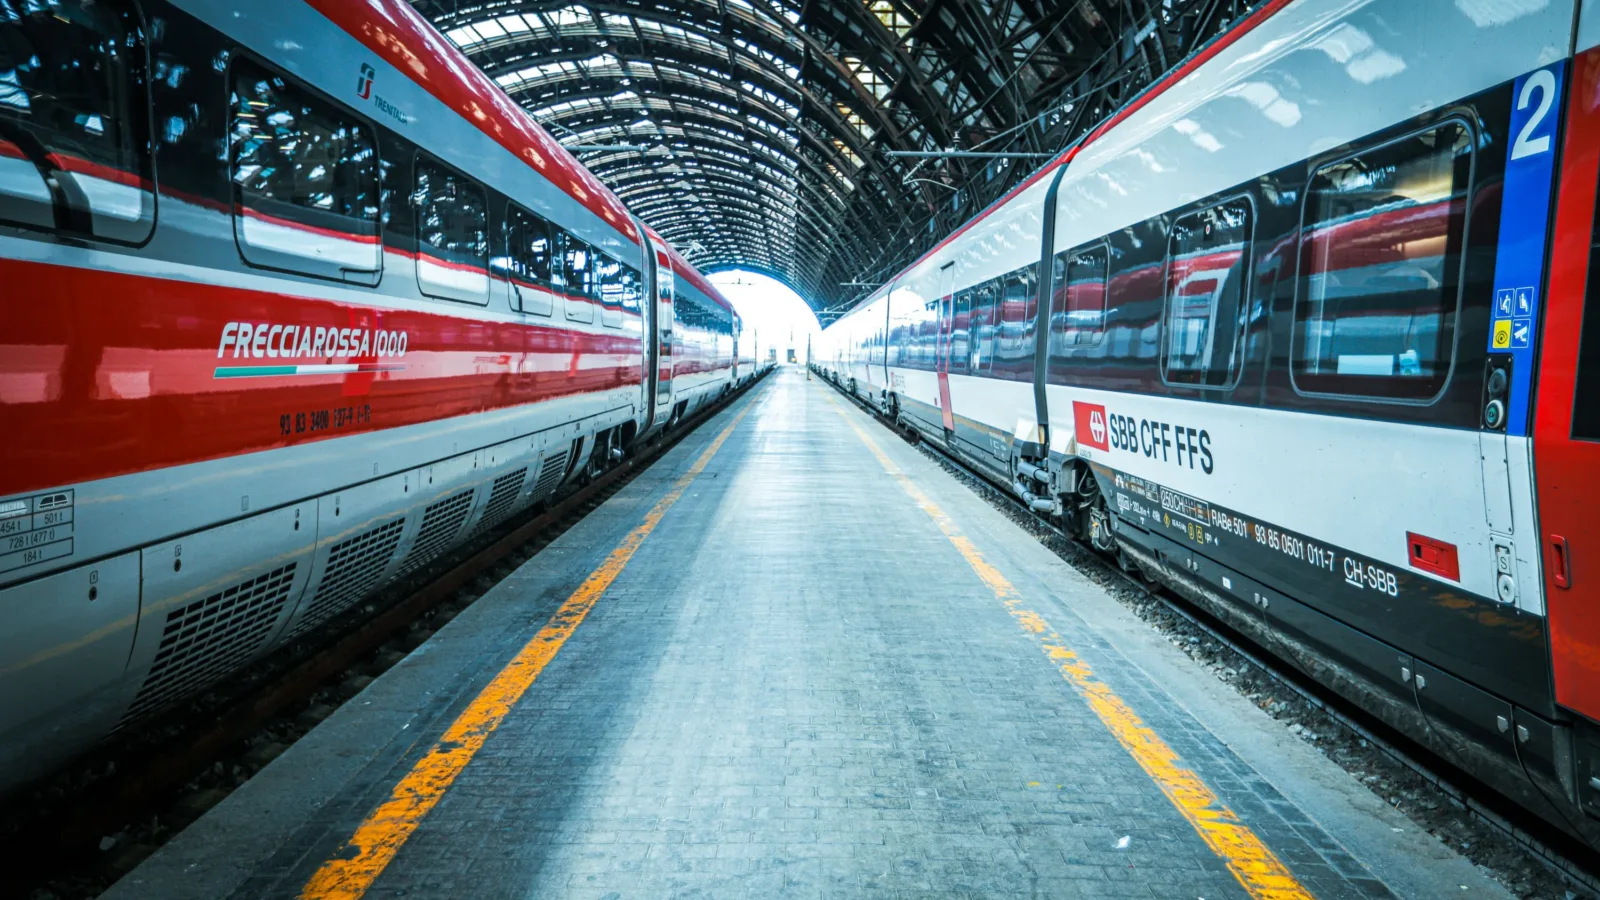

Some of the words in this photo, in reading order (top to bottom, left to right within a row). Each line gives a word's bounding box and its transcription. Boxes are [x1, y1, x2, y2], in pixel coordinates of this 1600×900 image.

[1510, 69, 1556, 161] 2
[217, 321, 370, 359] FRECCIAROSSA
[371, 330, 408, 358] 1000
[280, 413, 291, 435] 93
[295, 412, 306, 433] 83
[310, 409, 329, 431] 3400
[1109, 413, 1139, 453] SBB
[1140, 418, 1171, 462] CFF
[1174, 425, 1214, 475] FFS
[0, 521, 16, 533] 454
[44, 513, 58, 524] 501
[9, 536, 24, 549] 728
[31, 531, 48, 544] (477
[24, 550, 37, 563] 184
[1211, 508, 1232, 533] RABe
[1233, 516, 1248, 539] 501
[1254, 523, 1266, 545] 93
[1267, 528, 1280, 550] 85
[1281, 533, 1304, 560] 0501
[1307, 543, 1334, 572] 011-7
[1343, 556, 1398, 597] CH-SBB
[1500, 556, 1508, 570] S
